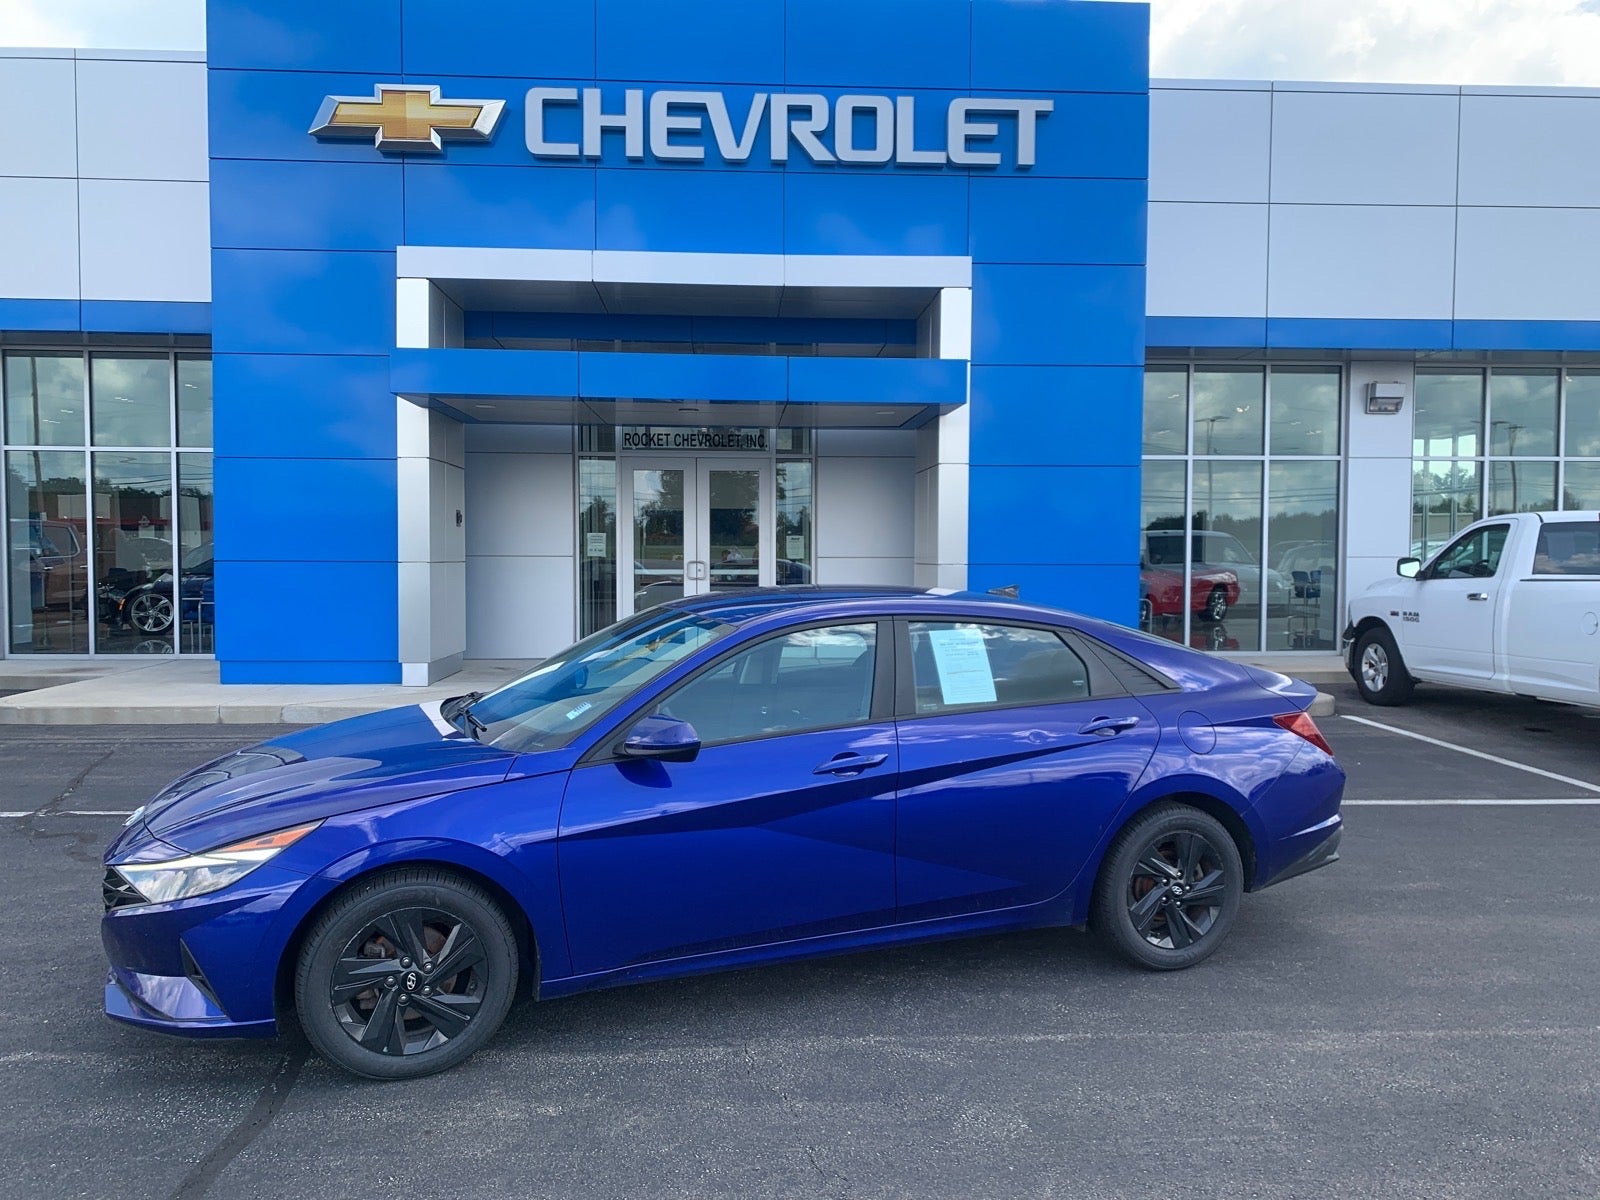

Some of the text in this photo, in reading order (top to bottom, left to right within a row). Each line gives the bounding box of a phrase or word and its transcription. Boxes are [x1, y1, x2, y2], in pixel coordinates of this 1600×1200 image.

[524, 86, 1054, 169] CHEVROLET
[624, 432, 671, 447] ROCKET
[746, 434, 768, 448] INC.
